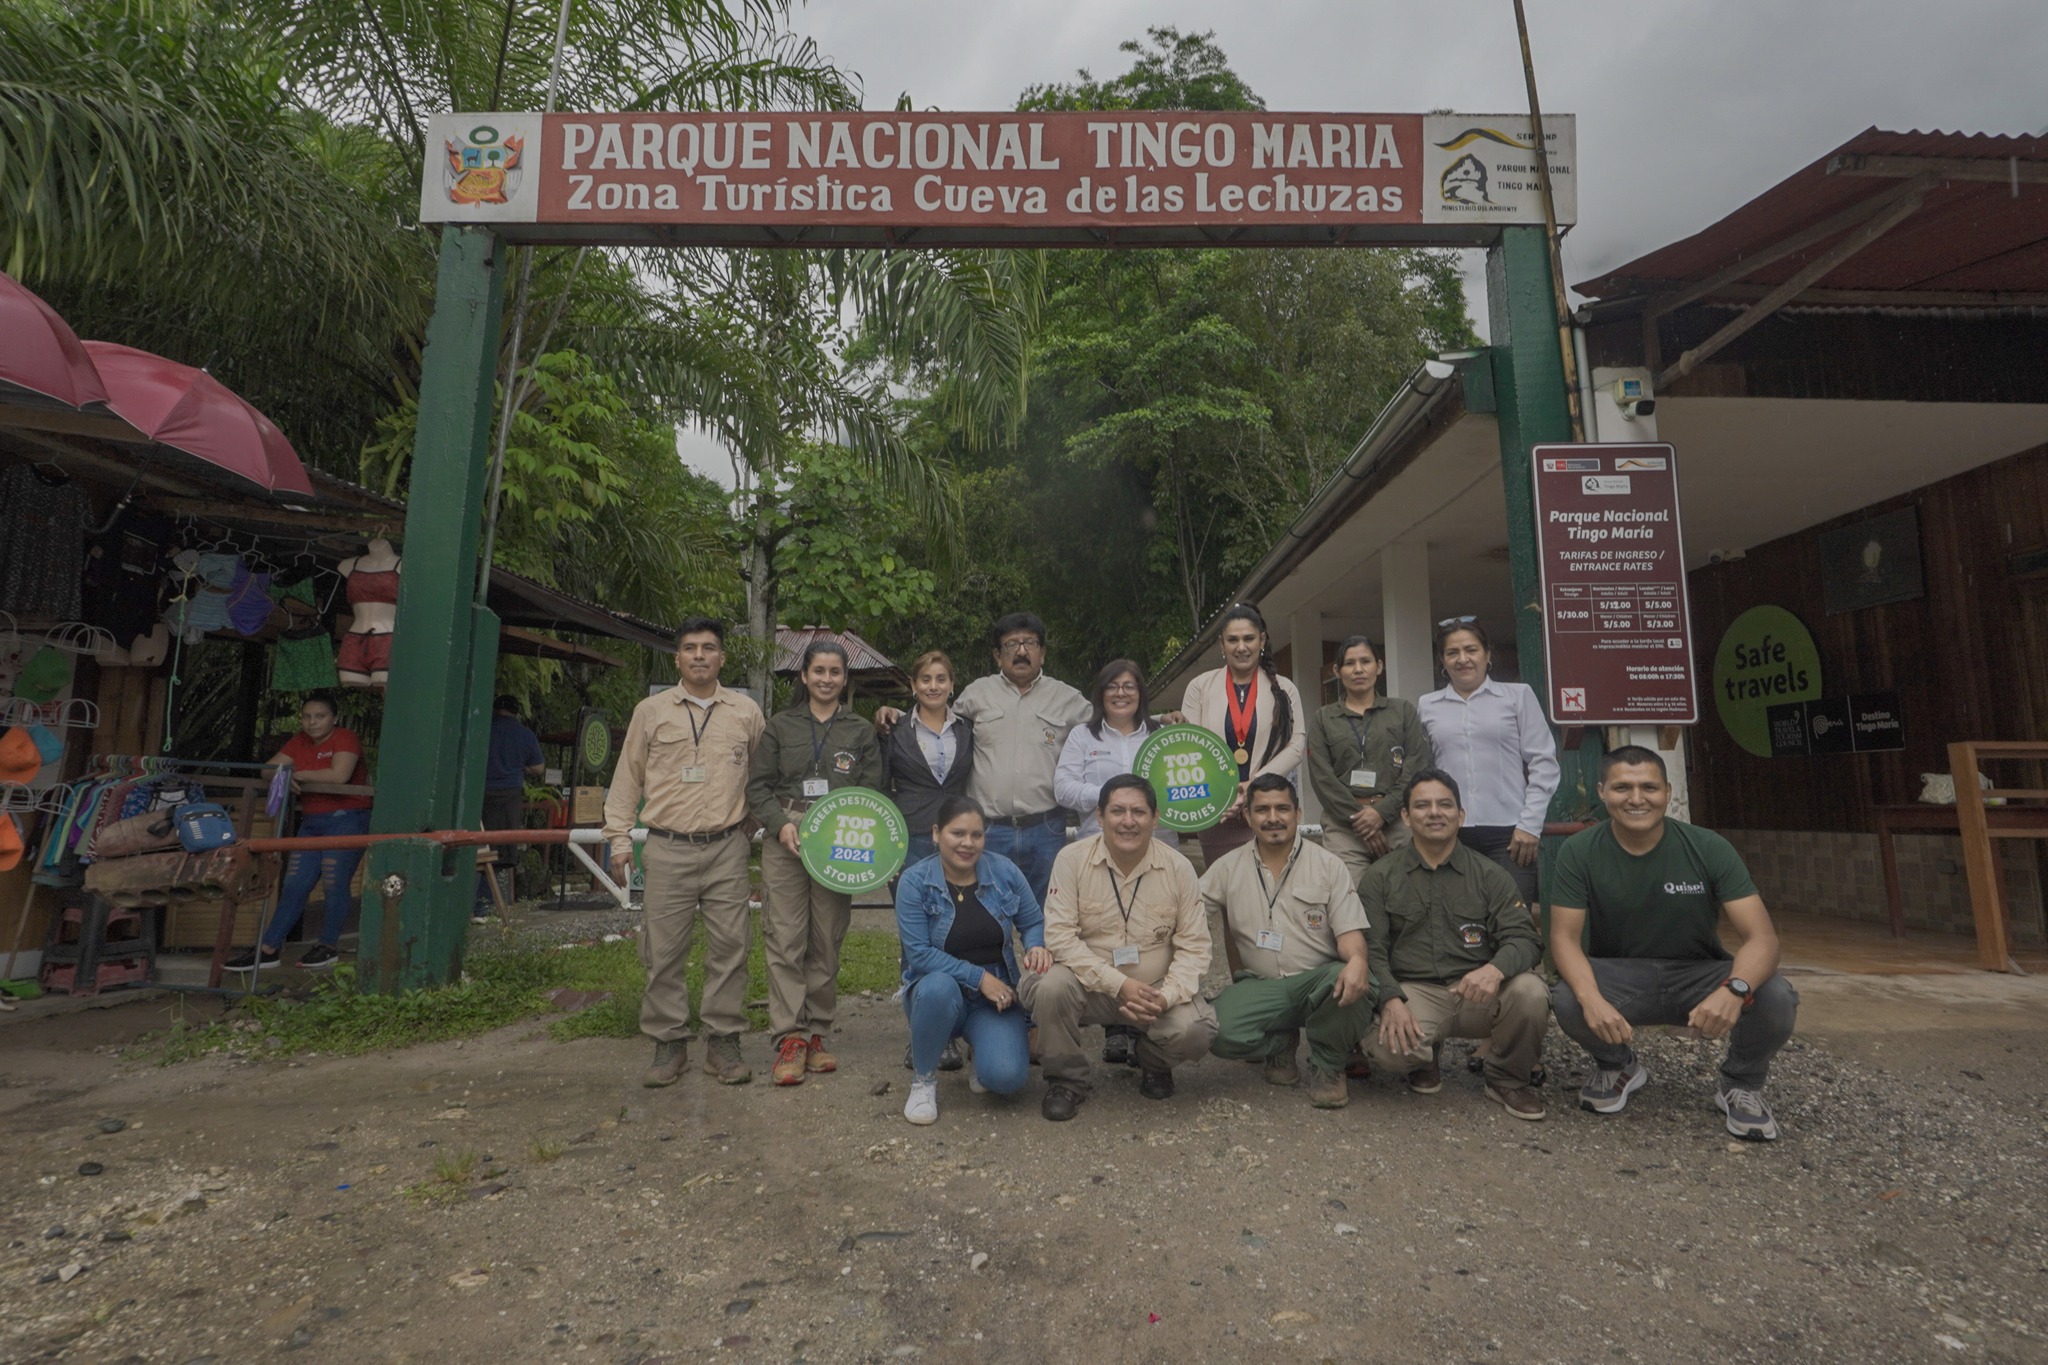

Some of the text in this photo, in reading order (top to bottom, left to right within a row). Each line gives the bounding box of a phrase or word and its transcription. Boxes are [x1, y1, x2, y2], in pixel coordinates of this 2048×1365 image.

[1517, 133, 1557, 141] SERNP
[561, 120, 1403, 178] PARQUE NACIONAL TINGO MARIA
[1496, 164, 1571, 174] PARQUE NAONAL
[567, 172, 1403, 214] Zona Turística Cueva de las Lechuzas
[1498, 181, 1523, 191] TINGO
[1550, 509, 1668, 525] Parque Nacional
[1568, 525, 1653, 542] Tingo María
[1560, 551, 1598, 559] TARIFAS
[1600, 551, 1612, 559] DE
[1615, 551, 1657, 559] INGRESO
[1570, 562, 1653, 571] ENTRANCE RATES
[1645, 601, 1672, 609] S/5.00
[1557, 611, 1589, 619] S/30.00
[1604, 620, 1631, 629] S/5.00
[1647, 620, 1674, 628] S/3.00
[1735, 635, 1786, 670] Safe
[1725, 662, 1809, 701] travels
[1861, 711, 1890, 722] Destino
[1856, 719, 1899, 733] Tingo María
[1141, 733, 1228, 779] GREEN DESTINATIONS
[1163, 752, 1202, 768] TOP
[1166, 766, 1205, 786] 100
[1171, 785, 1206, 800] 2024
[810, 796, 899, 842] GREEN DESTINATIONS
[1166, 803, 1216, 822] STORIES
[837, 814, 876, 830] TOP
[834, 829, 874, 848] 100
[834, 848, 870, 862] 2024
[824, 865, 876, 883] STORIES
[1664, 881, 1704, 894] Quispi
